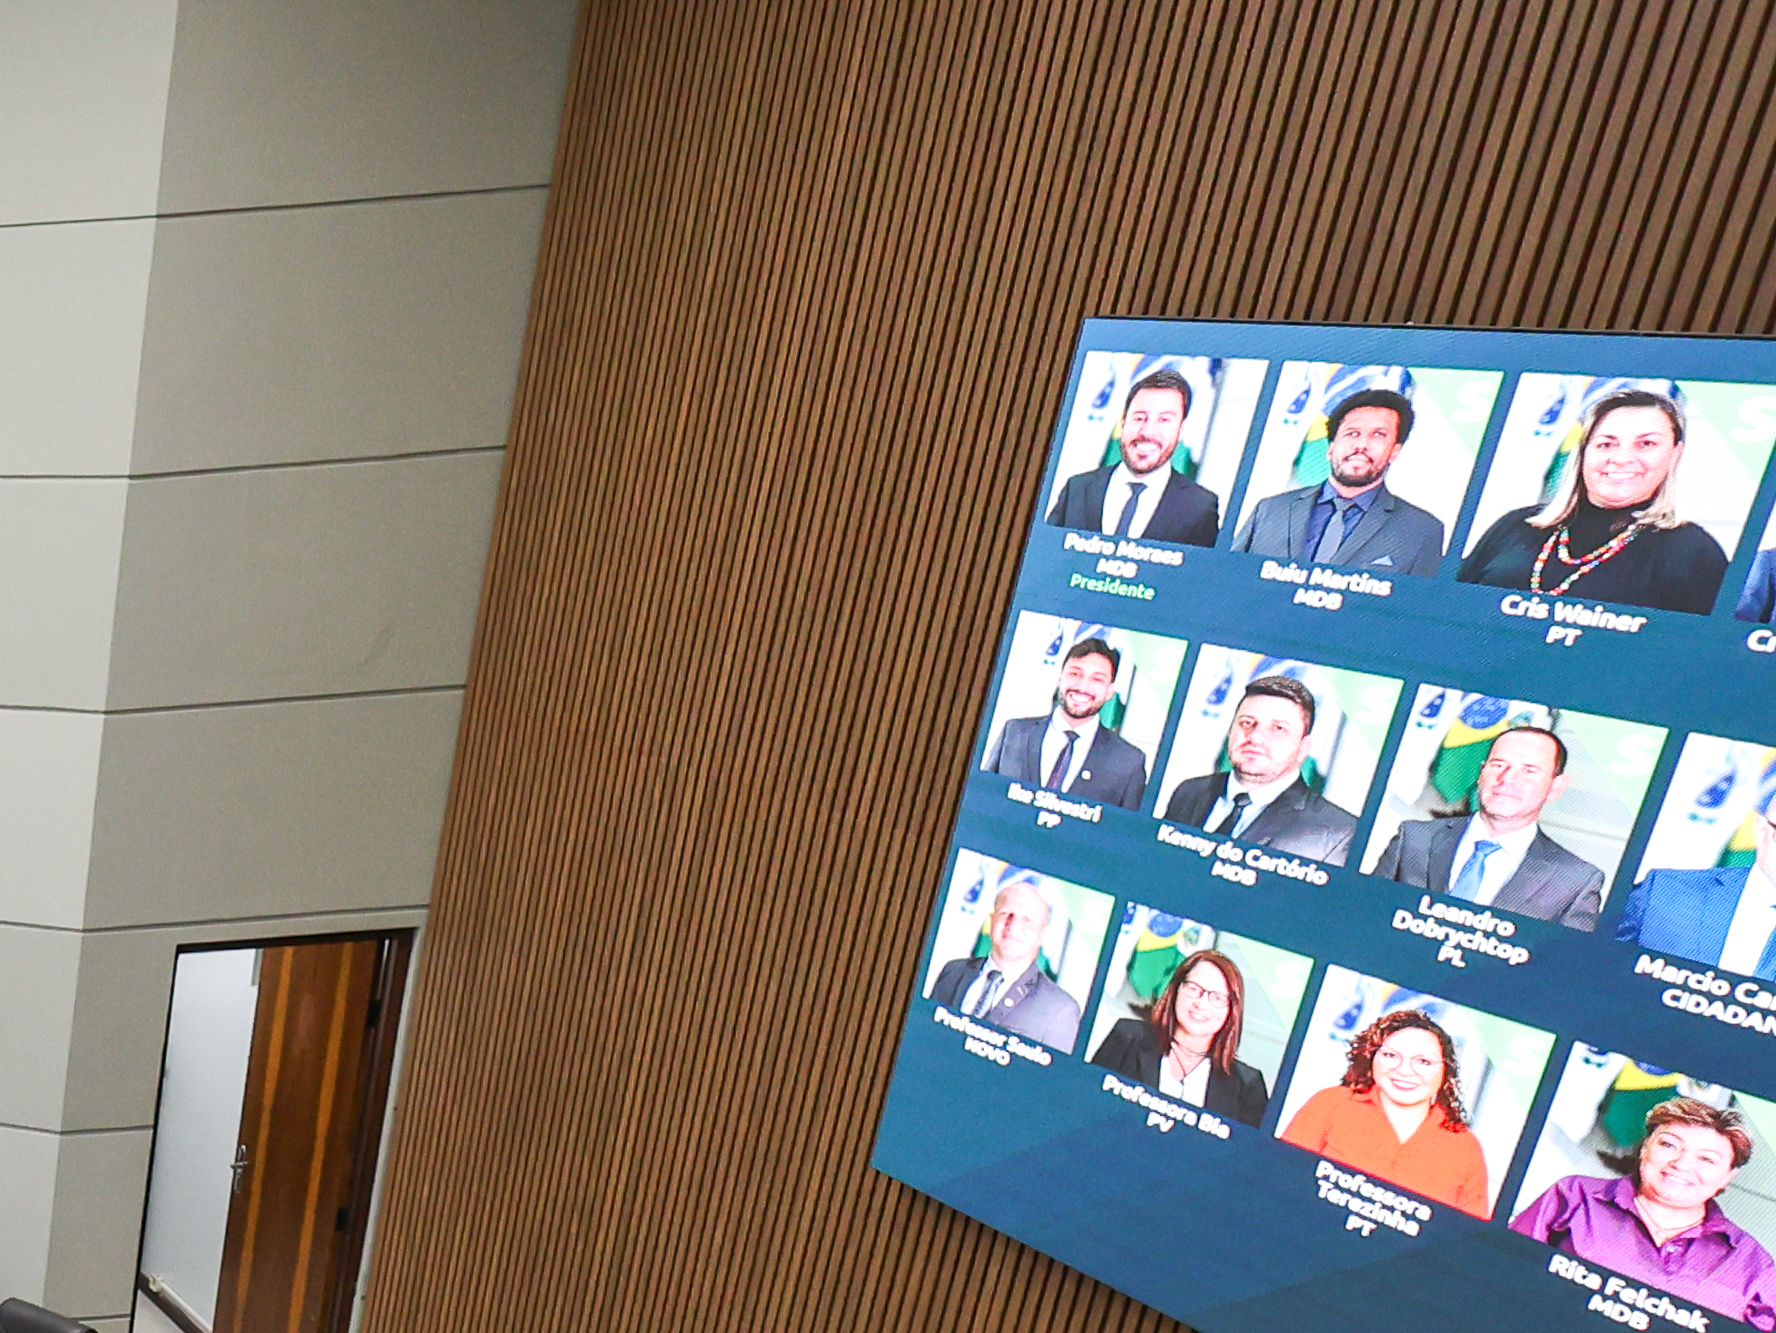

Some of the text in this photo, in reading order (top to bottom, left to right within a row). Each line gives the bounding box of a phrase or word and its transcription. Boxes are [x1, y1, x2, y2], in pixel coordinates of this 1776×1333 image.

[1070, 573, 1155, 600] Presidente
[1260, 560, 1393, 597] Buiu Martins
[1293, 588, 1344, 610] MDB
[1500, 595, 1648, 632] Cris Wainer
[1545, 626, 1583, 646] PT
[1156, 824, 1330, 886] Kenny do Cartório
[1211, 861, 1259, 886] MDB
[1418, 895, 1517, 937] Leandro
[1392, 909, 1532, 965] Dobrychtop
[1437, 945, 1466, 968] PL
[1634, 954, 1732, 996] Marcio
[1102, 1074, 1231, 1140] Professora Bia
[1147, 1112, 1176, 1133] PV
[1315, 1160, 1433, 1221] Professora
[1317, 1179, 1421, 1237] Terezinha
[1345, 1214, 1378, 1237] PT
[1548, 1253, 1711, 1333] Rita Felchak
[1587, 1294, 1652, 1331] MDB
